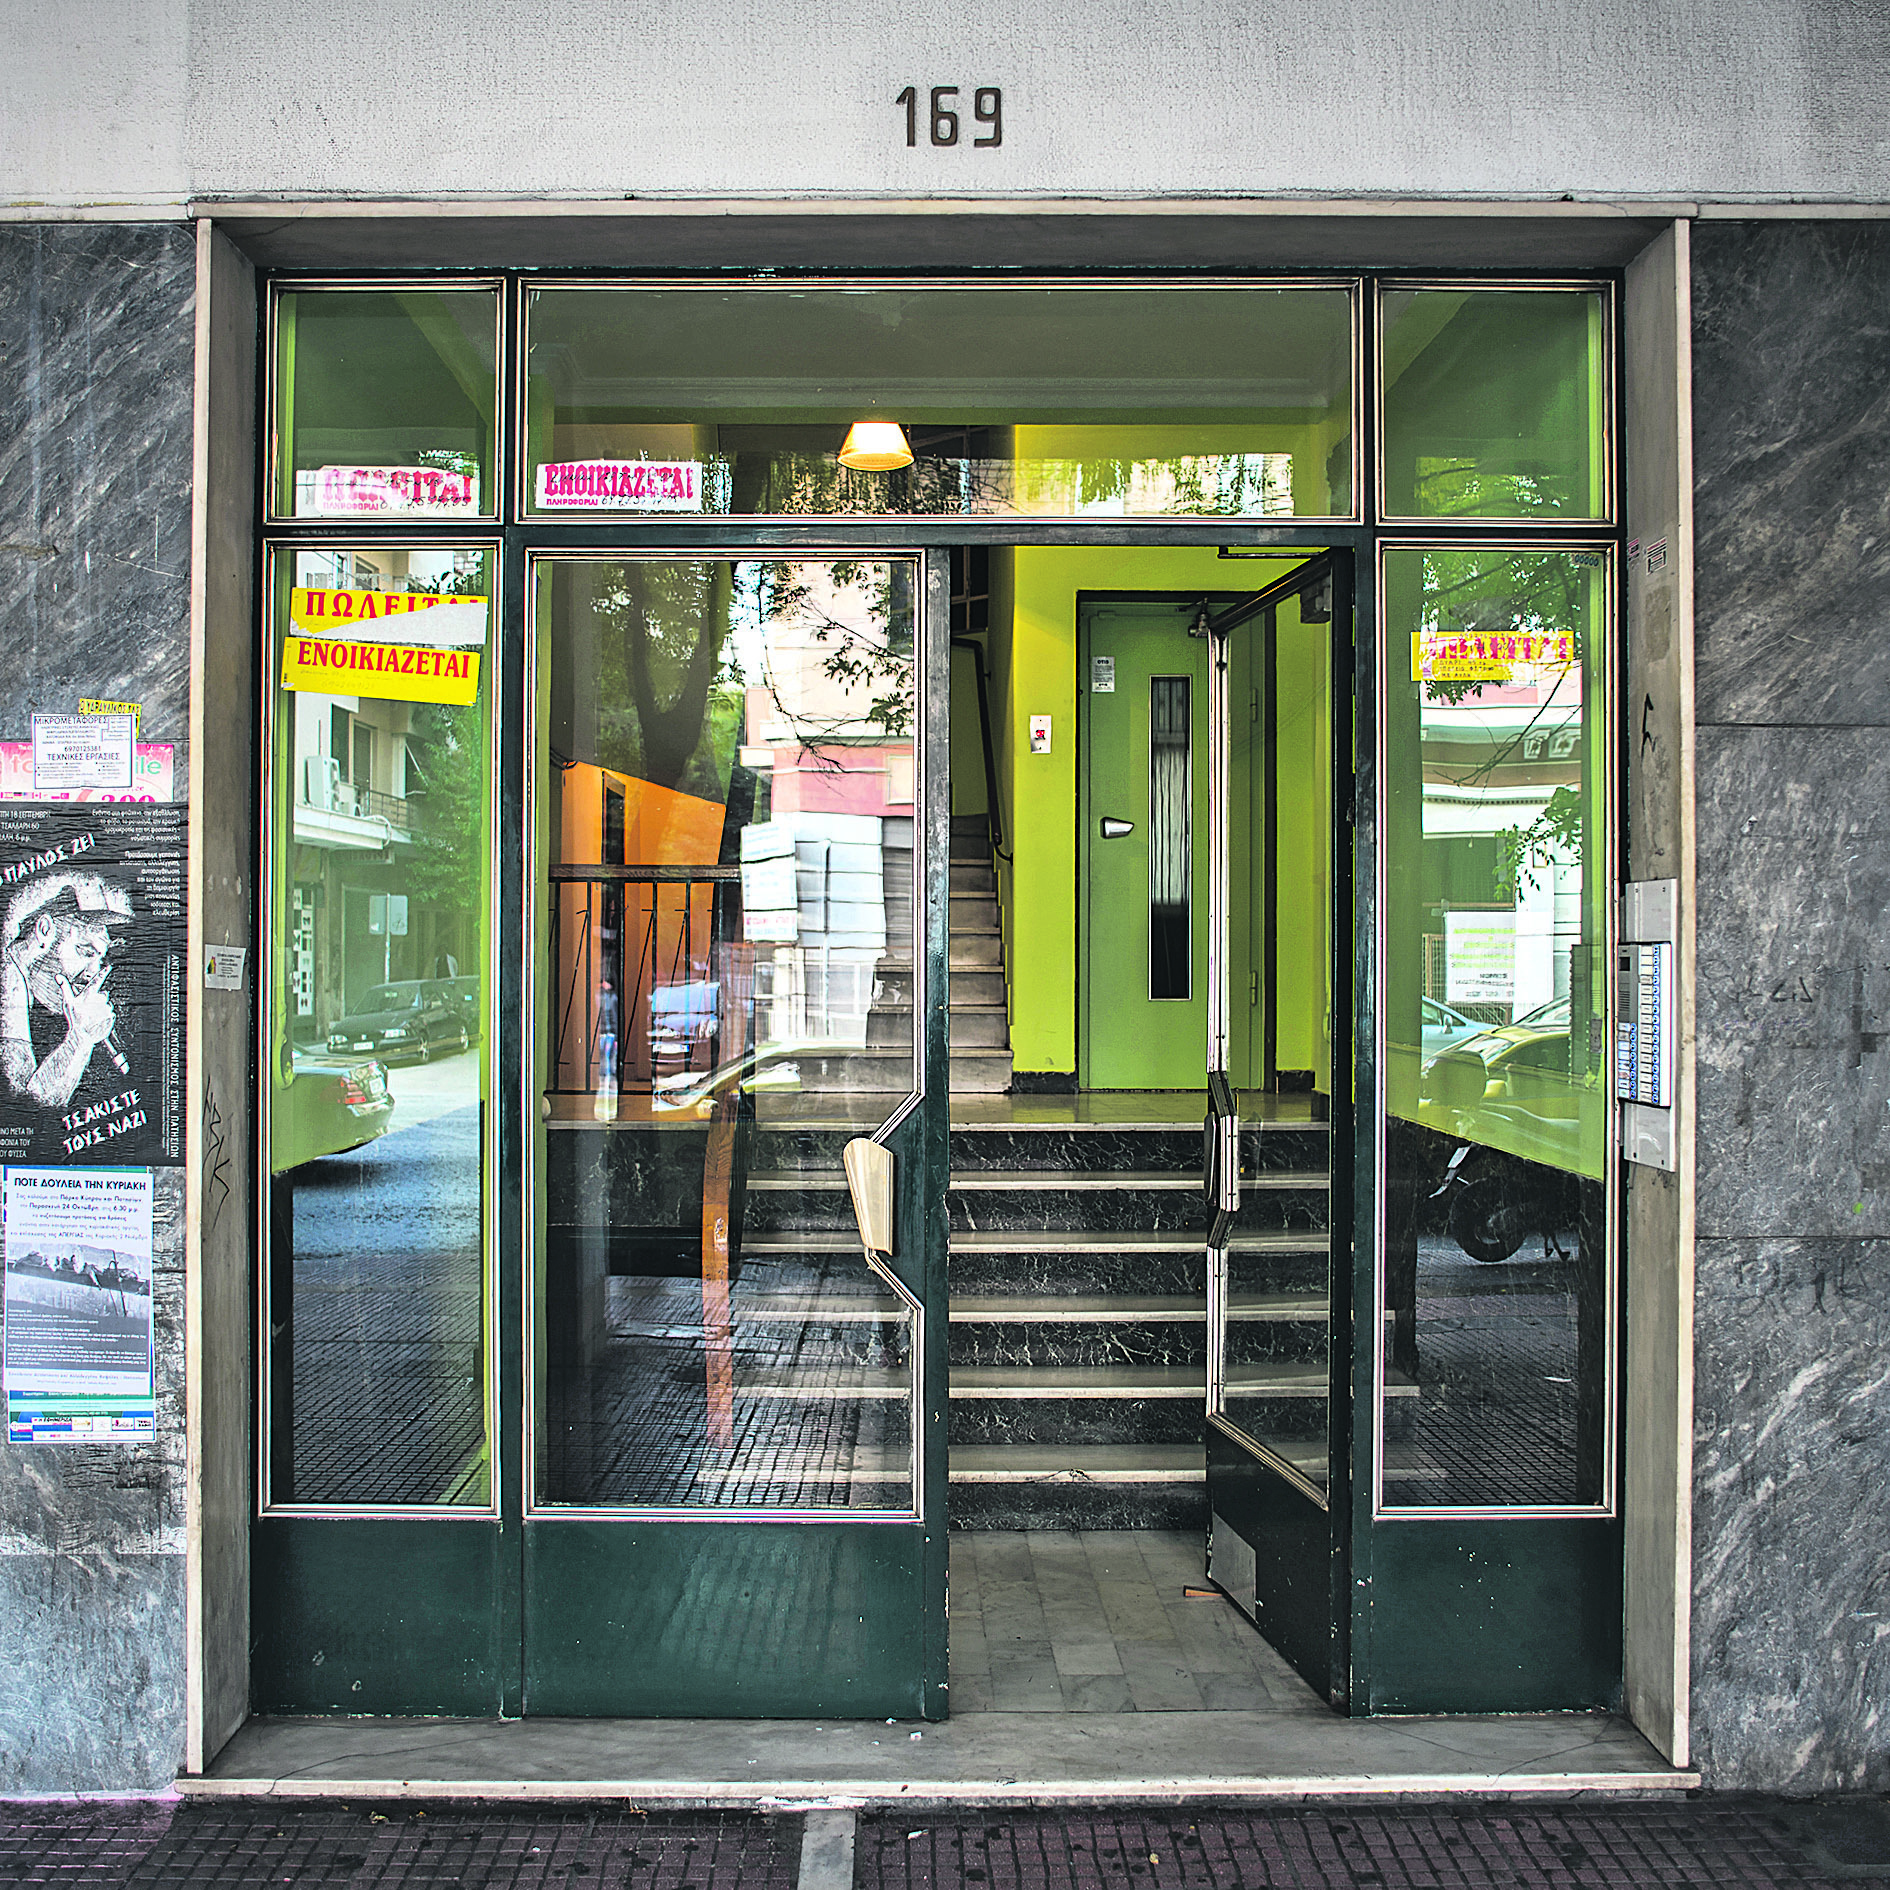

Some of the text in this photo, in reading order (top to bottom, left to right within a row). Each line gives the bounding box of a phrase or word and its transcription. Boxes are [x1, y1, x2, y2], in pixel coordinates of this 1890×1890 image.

[895, 86, 1001, 147] 169
[545, 464, 694, 499] ΕΝΟΙΚΙΑΖΕΤΑΙ
[306, 591, 479, 619] ΠΩΛΕΙΤ
[298, 641, 470, 679] ΕΝΟΙΚΙΑΖΕΤΑΙ
[35, 716, 108, 726] ΜΙΚΡΟΜΕΤΑΦΟΡΕΣ
[47, 752, 120, 761] ΤΕΧΝΙΚΕΣ ΕΡΓΑΣΙΕΣ
[4, 832, 96, 883] ΠΑΥΛΟΣ ΖΕΙ
[170, 954, 180, 1158] ΑΝΤΙΦΑΣΙΣΤΙΚΟΣ ΣΥΝΤΟΝΙΣΜΟΣ ΣΤΗΝ ΠΑΤΗΣΙΩΝ
[62, 1089, 142, 1131] ΤΣΑΚΙΣΤΕ
[10, 1127, 26, 1135] ΜΕΤΑ
[62, 1109, 148, 1154] ΤΟΥΣ ΝΑΖΙ
[14, 1178, 147, 1191] ΠΟΤΕ ΔΟΥΛΕΙΑ ΤΗΝ ΚΥΡΙΑΚΗ
